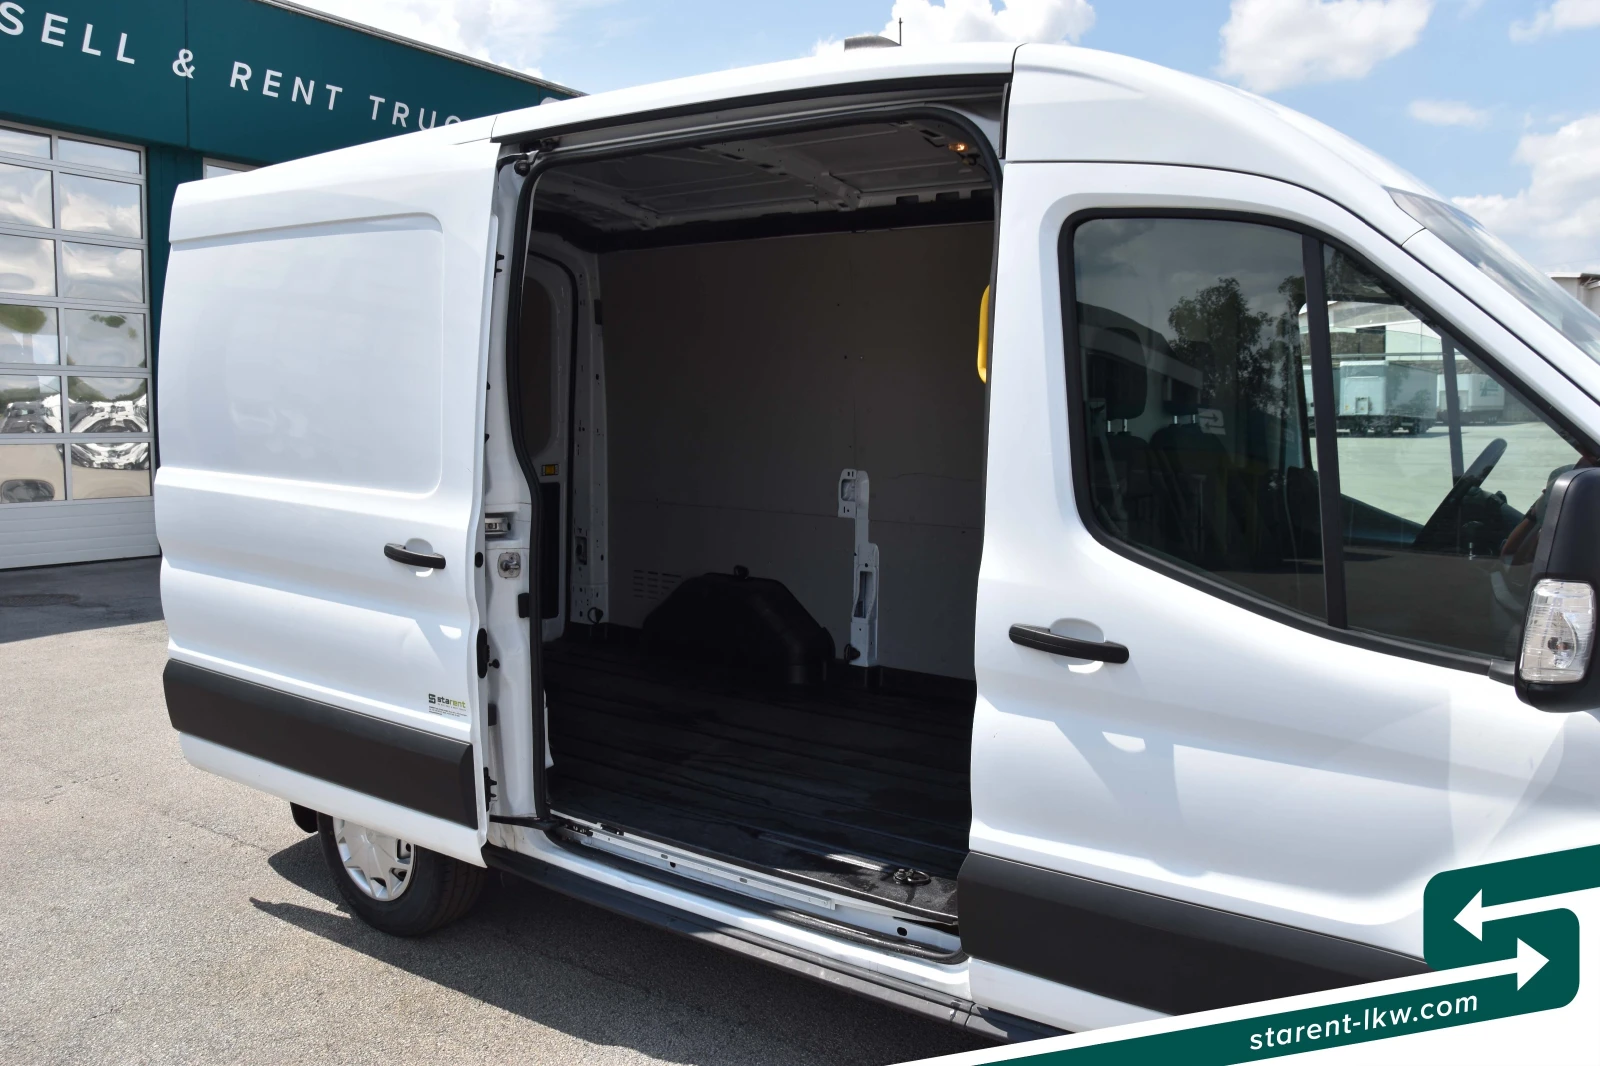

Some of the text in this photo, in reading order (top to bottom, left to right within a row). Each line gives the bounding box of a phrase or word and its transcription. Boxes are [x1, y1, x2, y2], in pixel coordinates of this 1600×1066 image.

[0, 1, 135, 65] SELL
[172, 48, 196, 79] &
[229, 60, 343, 111] RENT
[437, 696, 466, 708] starent
